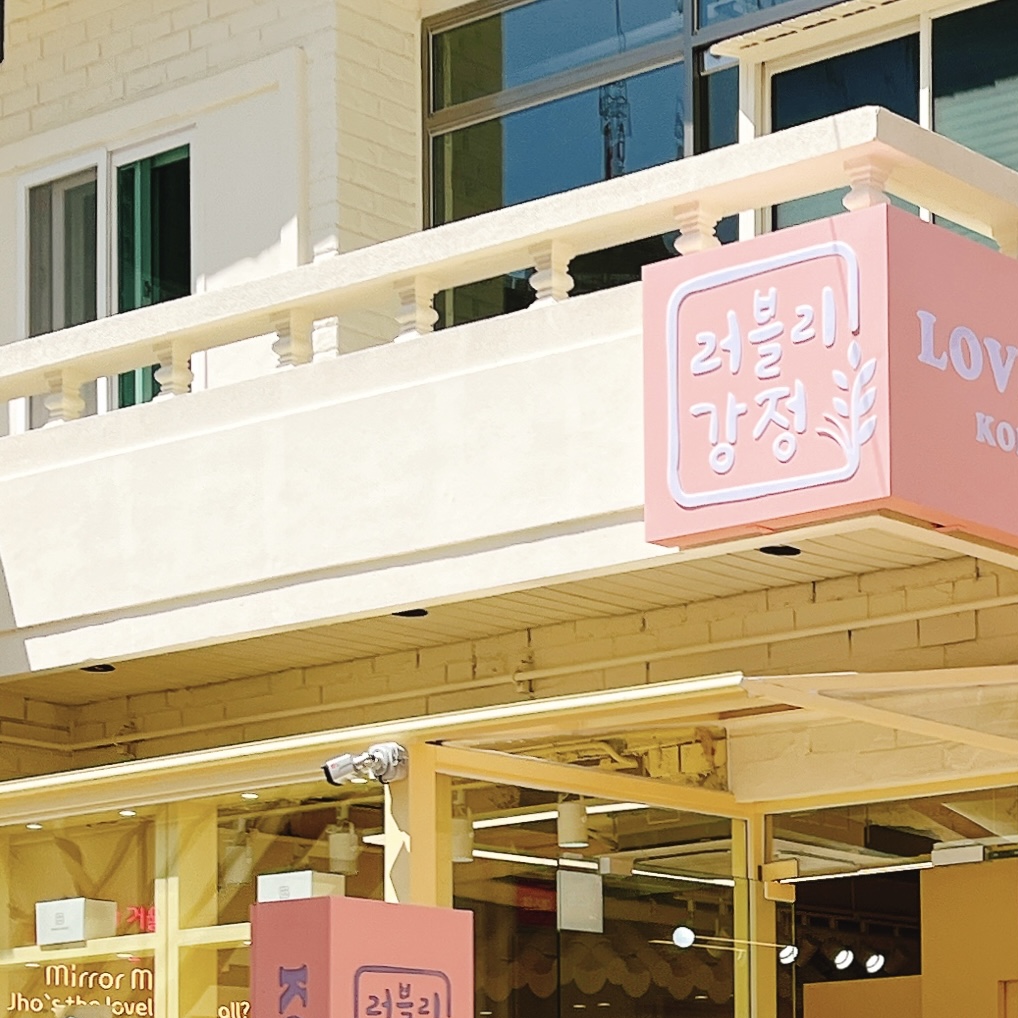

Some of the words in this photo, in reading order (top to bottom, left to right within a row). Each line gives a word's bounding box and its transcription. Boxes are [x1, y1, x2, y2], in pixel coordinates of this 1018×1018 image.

[690, 286, 837, 380] 러블리
[689, 378, 807, 475] 강정
[45, 964, 125, 990] Mirror
